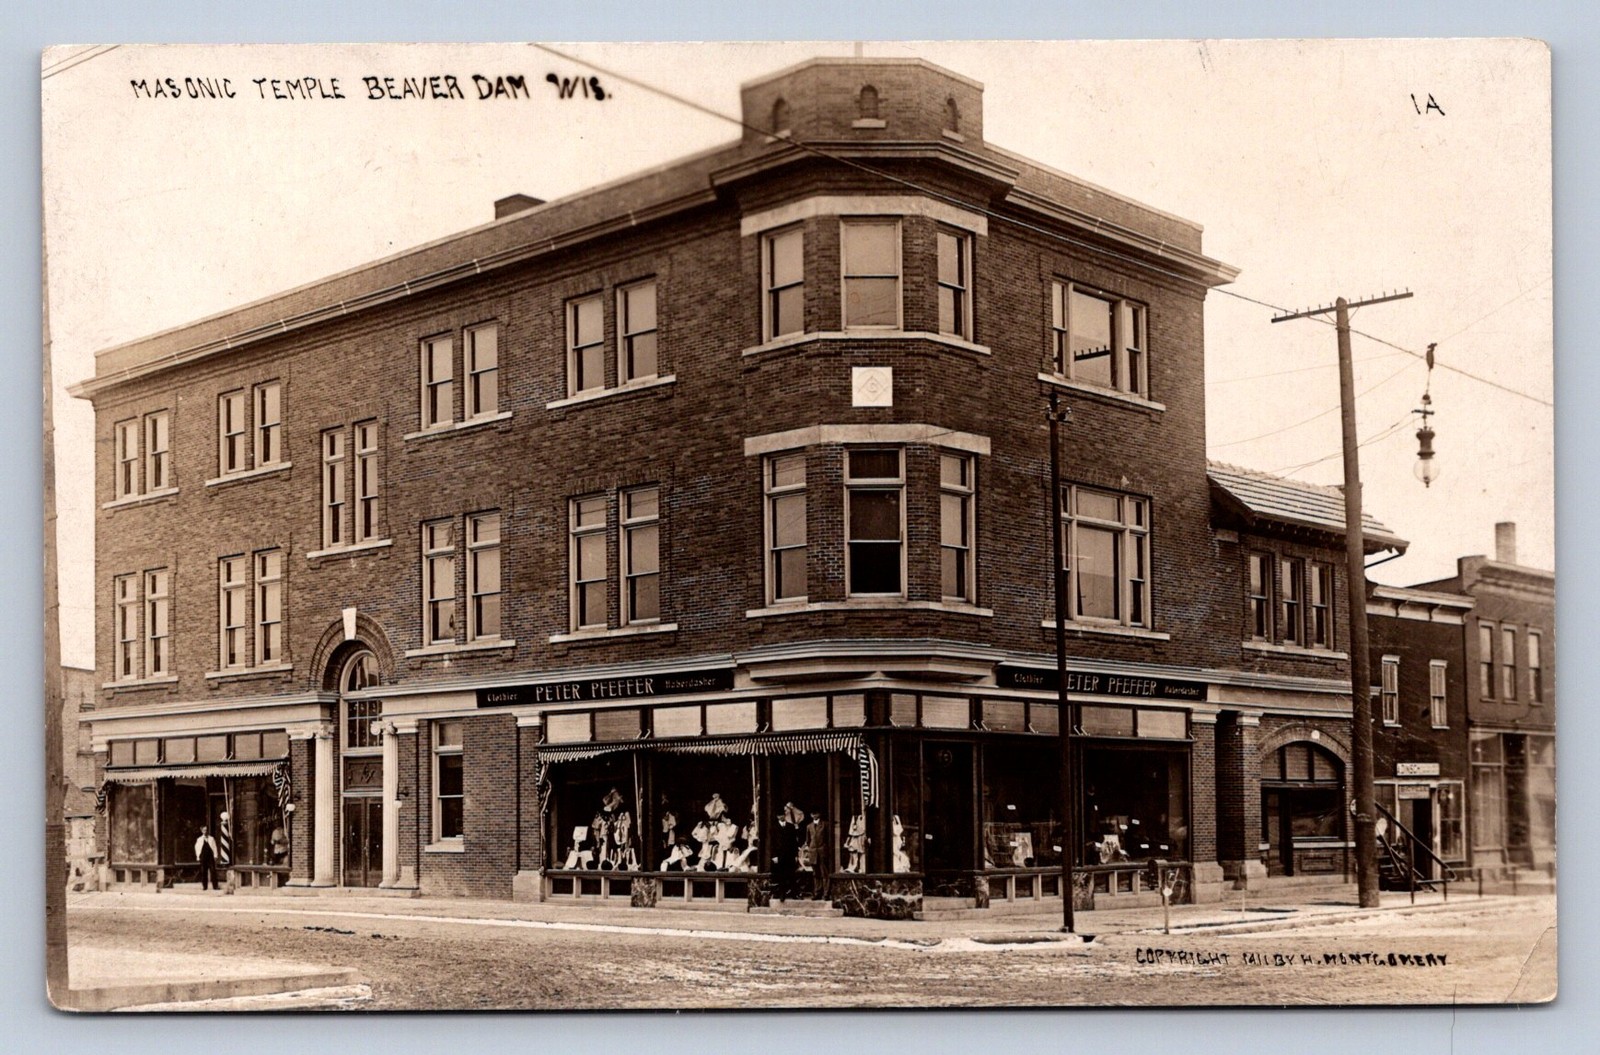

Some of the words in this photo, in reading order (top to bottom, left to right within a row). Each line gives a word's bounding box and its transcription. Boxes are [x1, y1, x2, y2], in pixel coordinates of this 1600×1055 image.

[535, 683, 581, 701] PETER
[591, 678, 654, 698] PFEFFER
[1066, 673, 1099, 691] ETER
[1107, 677, 1157, 695] PFEFFER
